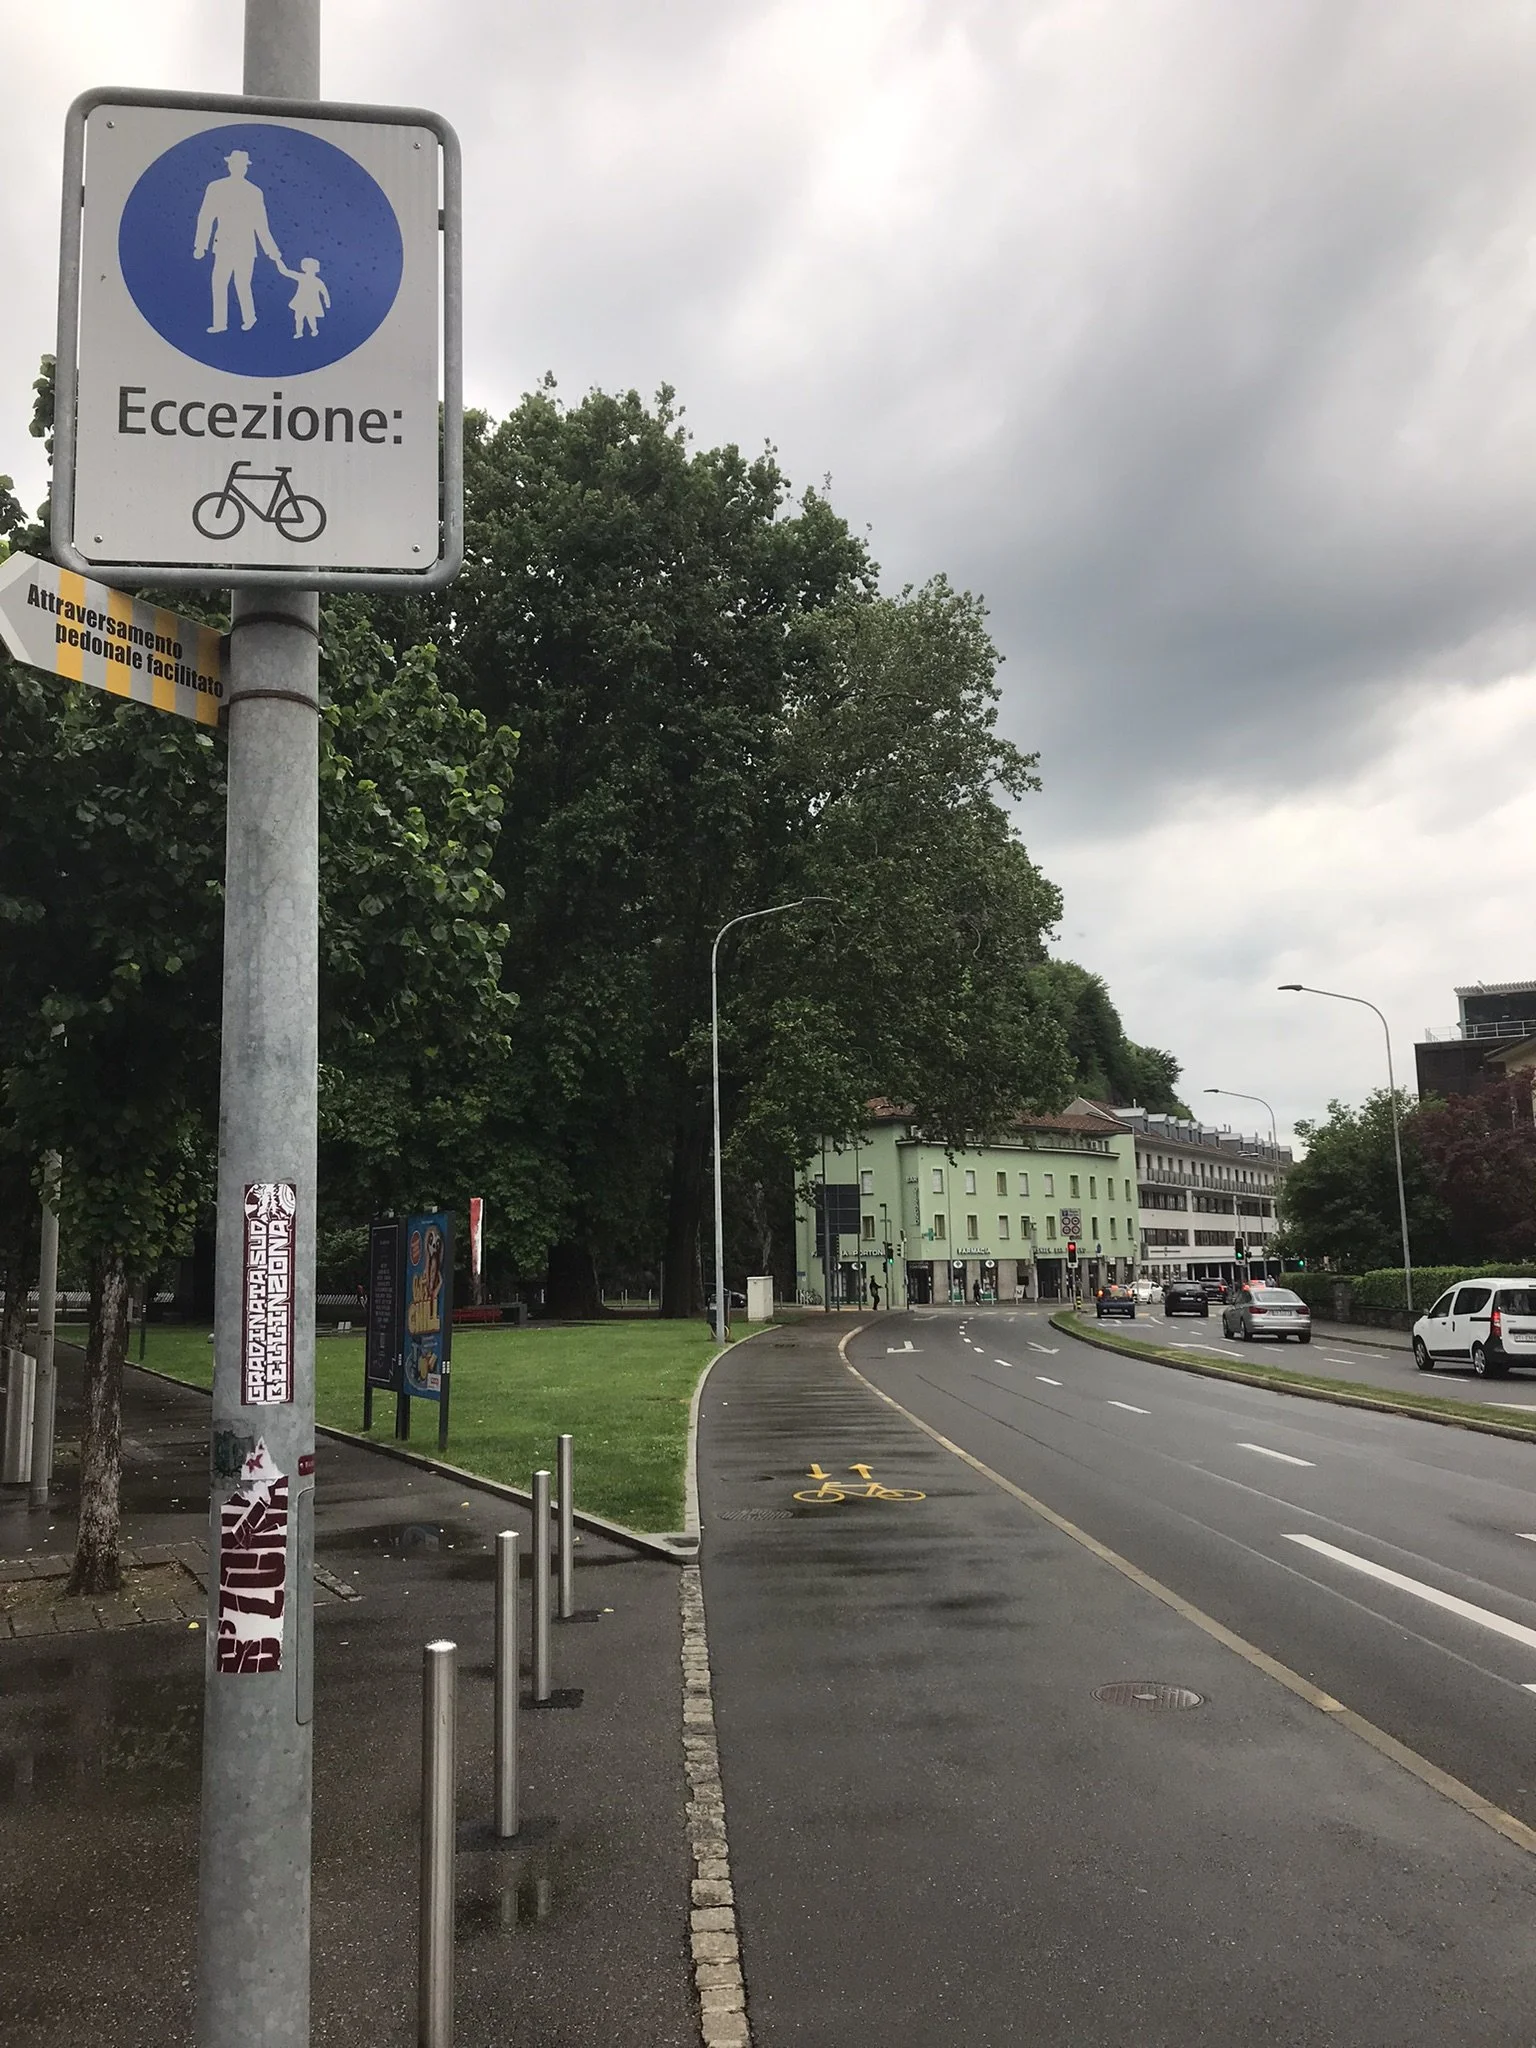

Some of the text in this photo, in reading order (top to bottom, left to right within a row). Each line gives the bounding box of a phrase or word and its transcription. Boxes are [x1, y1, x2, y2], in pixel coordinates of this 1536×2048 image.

[118, 385, 403, 444] Eccezione:
[26, 582, 184, 660] Attraversamento
[54, 621, 224, 698] pedonale facilitato
[956, 1247, 992, 1255] FARMACIA
[247, 1219, 268, 1402] GRADINATA SUD
[266, 1218, 290, 1402] BELLINZONA
